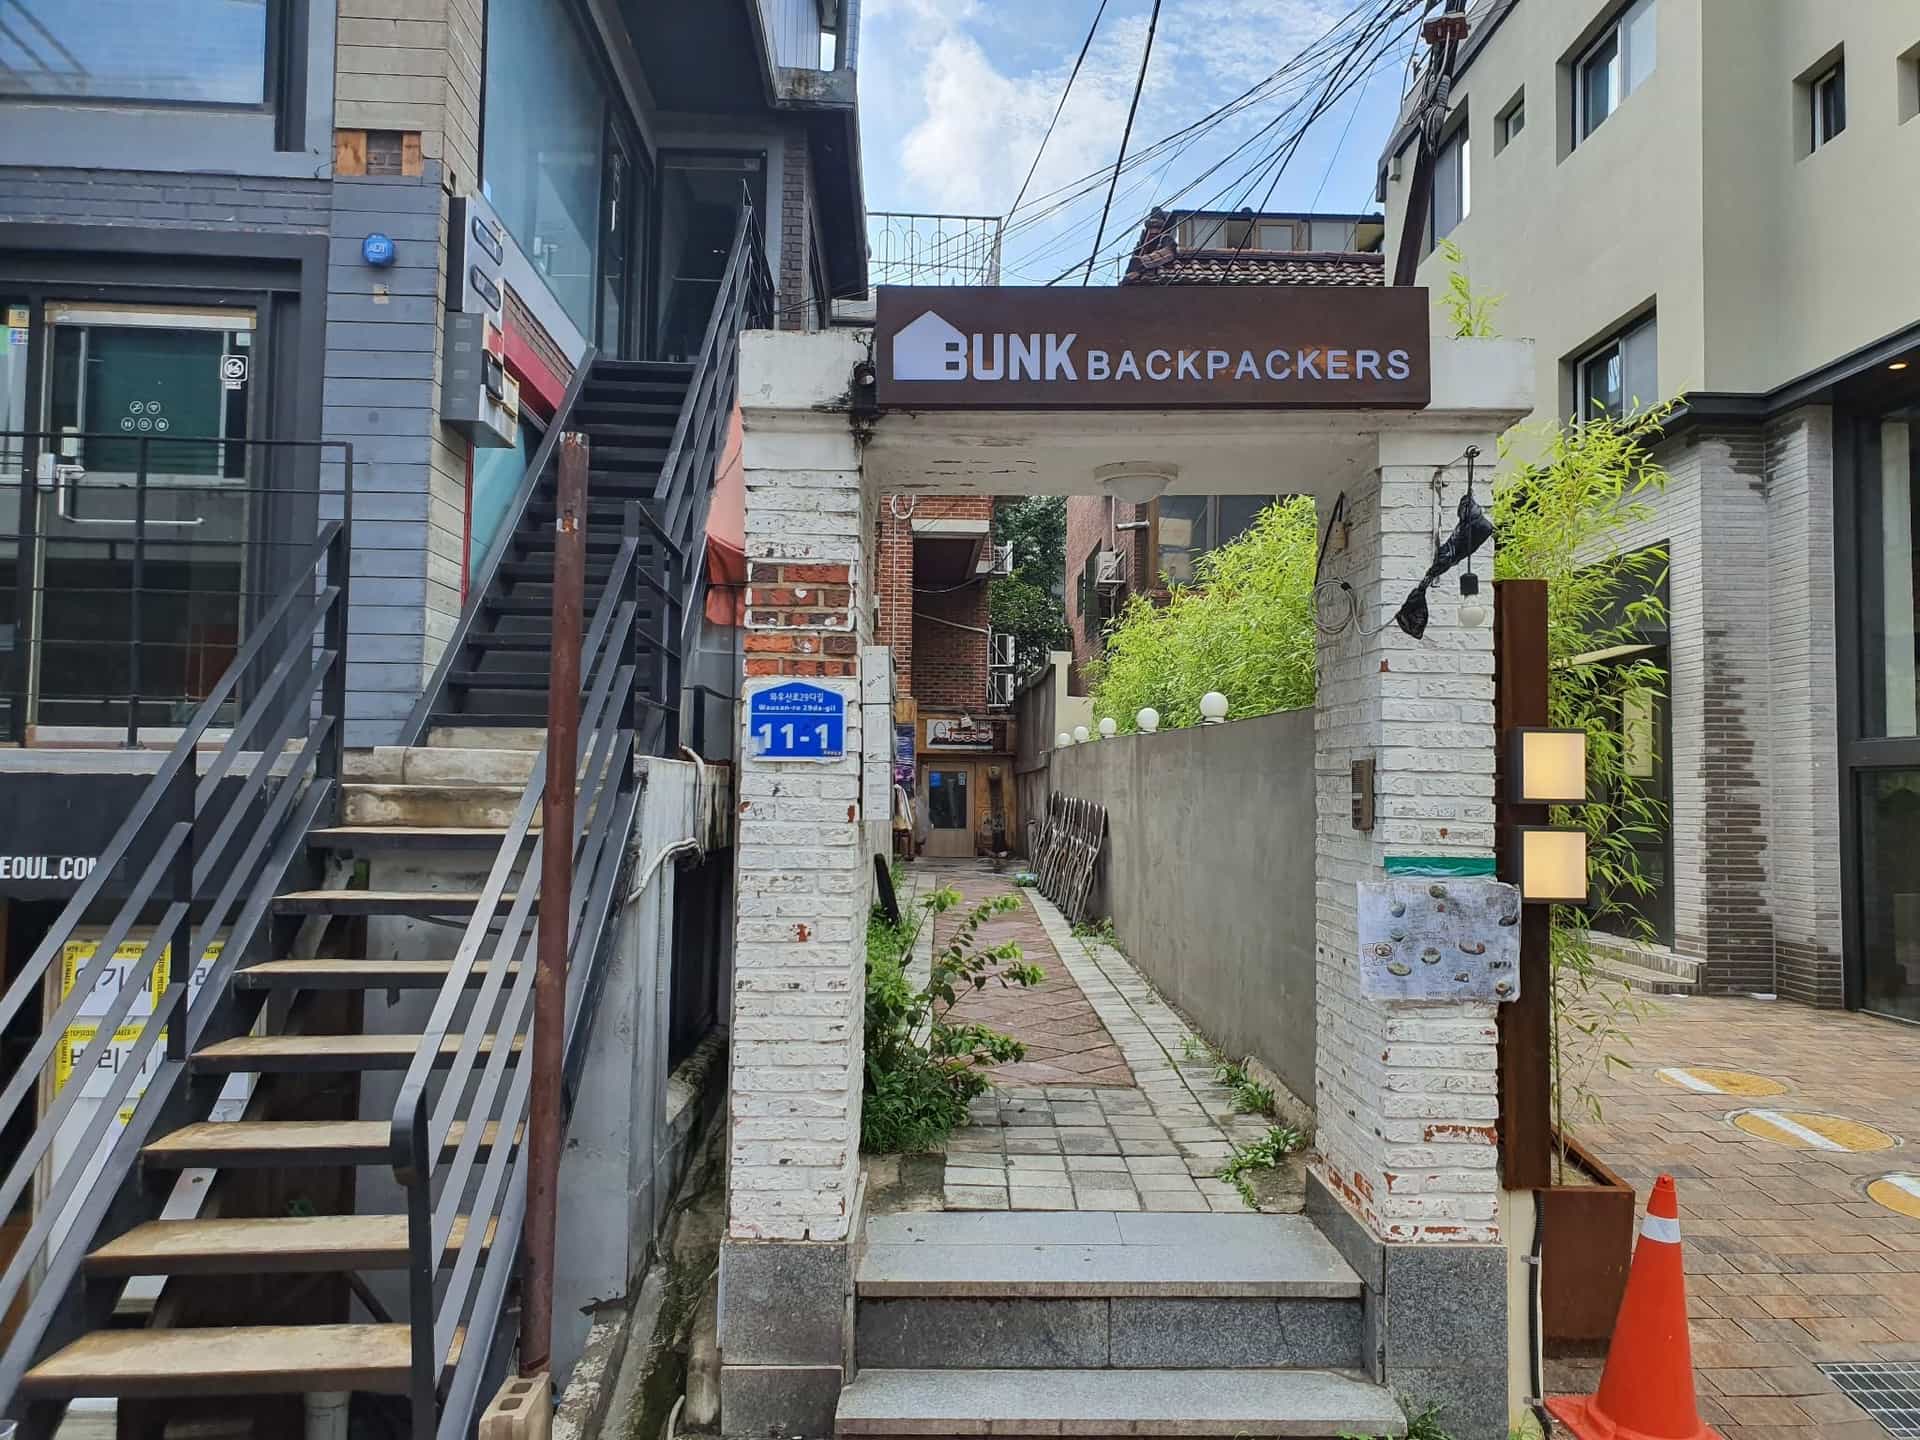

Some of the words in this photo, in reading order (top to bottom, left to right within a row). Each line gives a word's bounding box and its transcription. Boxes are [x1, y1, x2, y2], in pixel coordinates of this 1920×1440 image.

[928, 332, 1079, 381] BUNK
[1087, 349, 1410, 381] BACKPACKERS
[758, 723, 828, 749] 11-1
